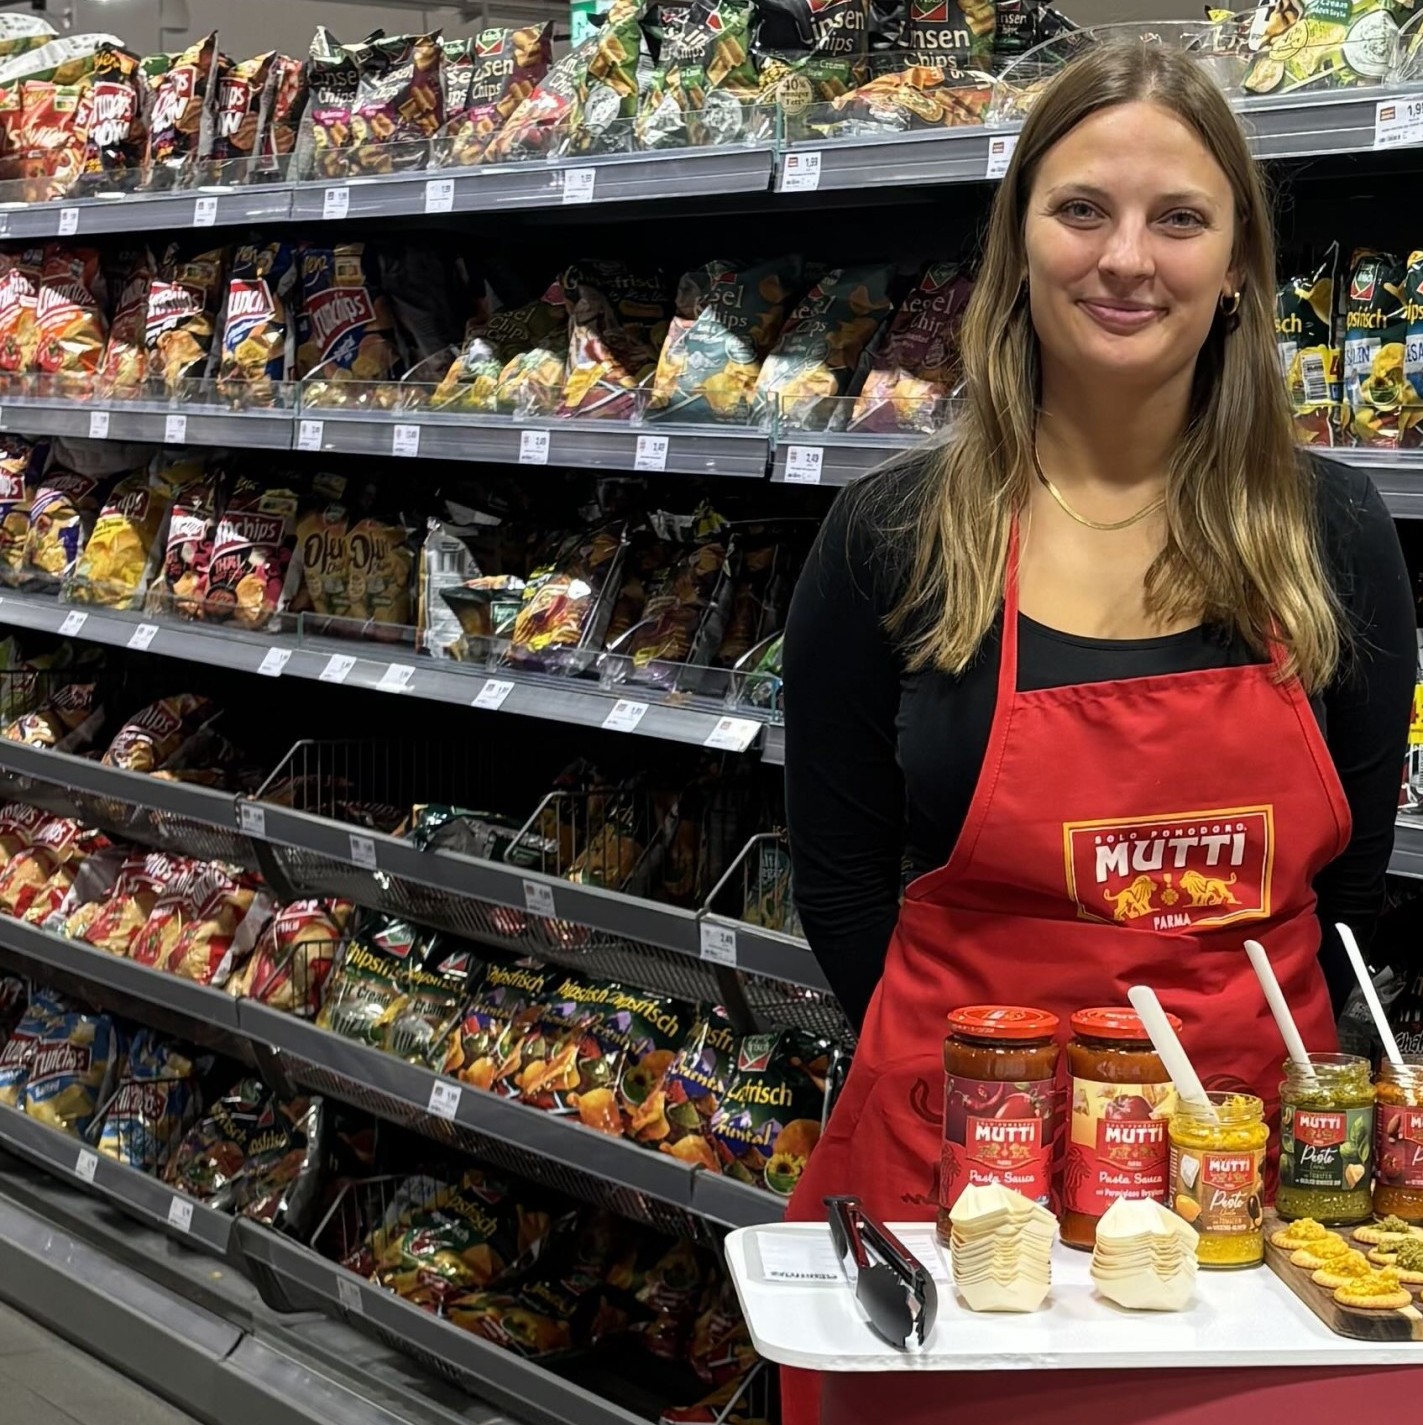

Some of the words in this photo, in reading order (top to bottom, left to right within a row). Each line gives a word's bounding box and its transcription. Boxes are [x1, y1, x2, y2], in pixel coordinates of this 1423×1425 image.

[1001, 13, 1028, 25] nsen
[1347, 305, 1388, 331] psfrisch
[1095, 831, 1138, 845] SOLO
[1151, 822, 1248, 839] POMODORO.
[1095, 832, 1246, 884] MUTTI
[1153, 913, 1192, 931] PARMA
[1300, 1116, 1341, 1130] MUTTI
[976, 1124, 1035, 1143] MUTTI
[1105, 1125, 1163, 1144] MUTTI
[1300, 1145, 1338, 1165] Pesto
[1209, 1159, 1250, 1172] MUTTI
[969, 1169, 1000, 1184] Pasta
[1003, 1172, 1035, 1184] Sauce
[1099, 1171, 1130, 1184] Pasta
[1134, 1173, 1163, 1184] Sauce
[1209, 1189, 1247, 1211] Pesto
